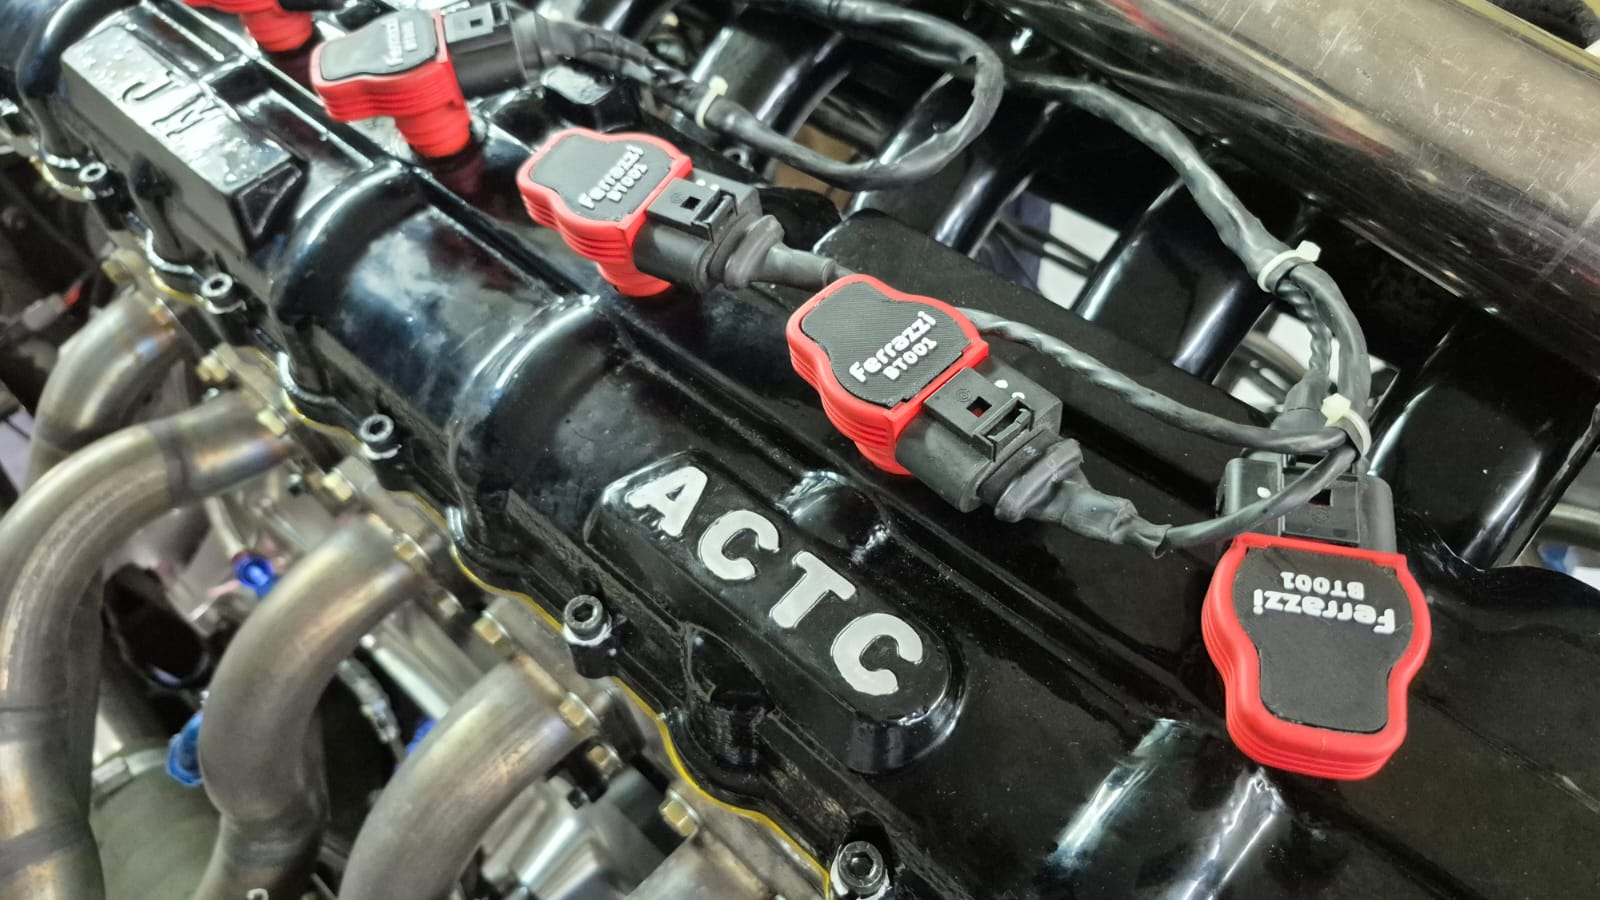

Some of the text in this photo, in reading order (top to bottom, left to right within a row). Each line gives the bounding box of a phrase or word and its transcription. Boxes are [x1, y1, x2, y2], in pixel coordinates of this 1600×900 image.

[578, 144, 645, 209] Ferrazzi
[848, 310, 937, 384] Ferrazzi
[882, 337, 938, 381] BT001
[624, 465, 923, 696] ACTC
[1280, 571, 1366, 601] BT001
[1252, 588, 1396, 635] Ferrazzi
